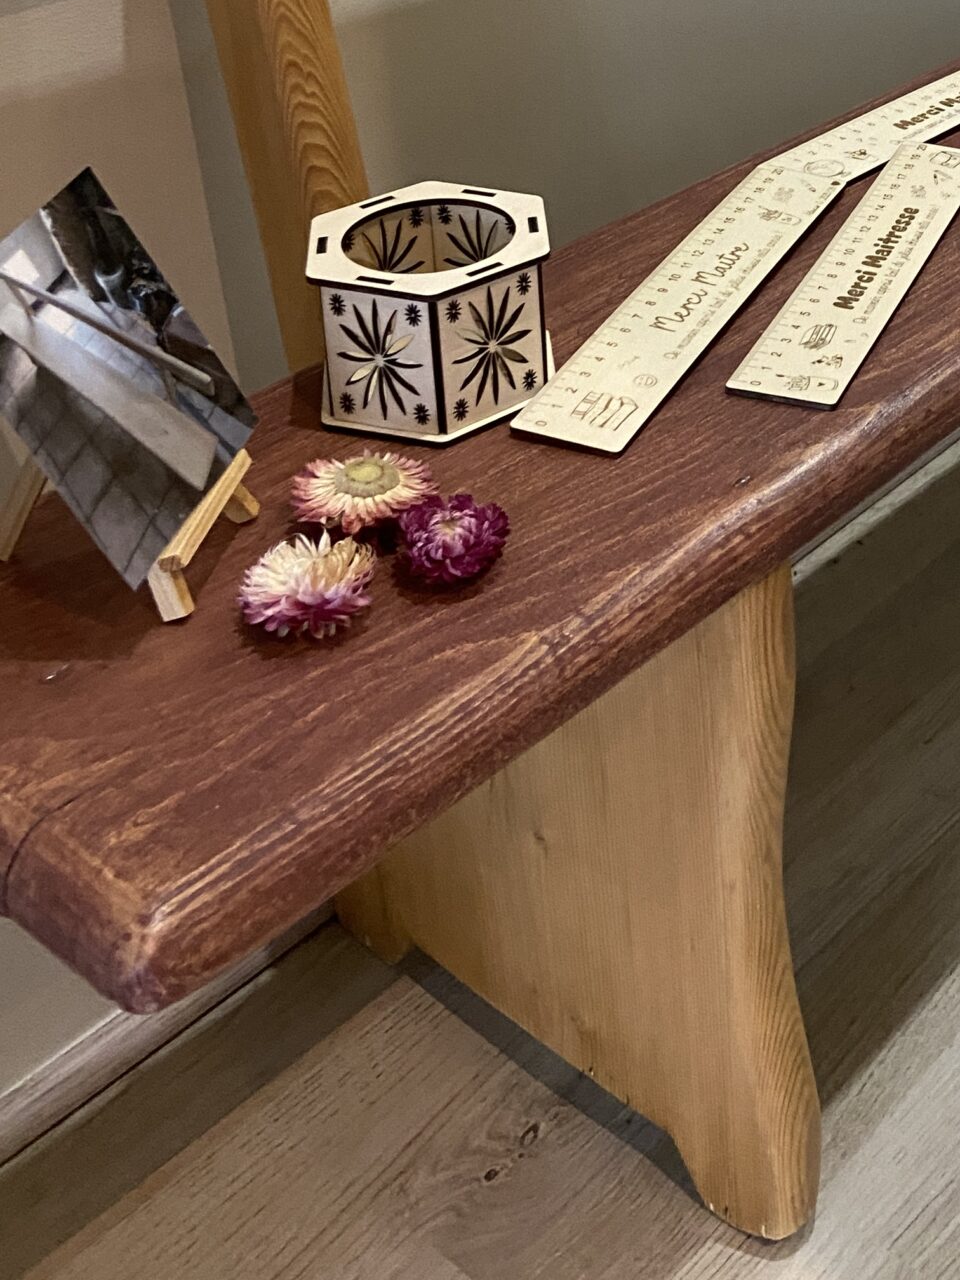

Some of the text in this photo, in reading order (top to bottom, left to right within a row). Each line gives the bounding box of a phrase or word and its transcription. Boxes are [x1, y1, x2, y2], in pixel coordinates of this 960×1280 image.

[892, 105, 946, 131] Merci
[832, 269, 878, 310] Merci
[861, 207, 920, 269] Maitresse
[648, 288, 709, 333] Merci
